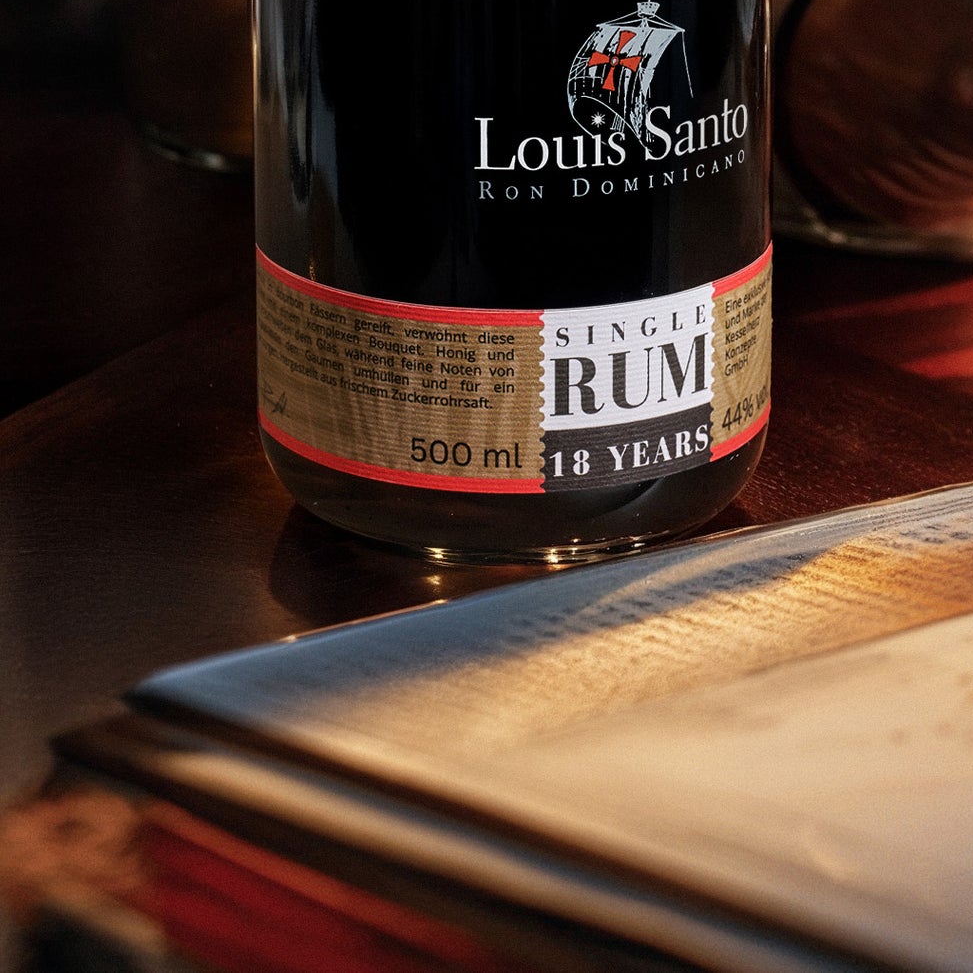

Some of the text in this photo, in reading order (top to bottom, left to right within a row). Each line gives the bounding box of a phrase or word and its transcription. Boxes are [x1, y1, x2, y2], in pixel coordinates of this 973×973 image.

[474, 98, 748, 171] Louis Santo
[724, 296, 743, 314] Eine
[724, 310, 741, 330] und
[306, 318, 360, 345] komplexen
[369, 335, 425, 356] Bouquet.
[436, 346, 476, 363] Honig
[487, 349, 515, 361] und
[404, 328, 468, 344] verwöhnt
[478, 332, 515, 345] diese
[555, 304, 707, 348] SINGLE
[305, 350, 345, 373] Gaumen
[353, 367, 410, 387] umhüllen
[422, 378, 448, 391] und
[460, 379, 481, 393] für
[493, 381, 515, 394] ein
[345, 348, 395, 368] während
[401, 357, 433, 373] feine
[440, 363, 482, 377] Noten
[489, 367, 515, 377] von
[550, 332, 709, 417] RUM
[724, 354, 749, 377] GmbH
[320, 374, 338, 388] aus
[340, 376, 388, 398] frischem
[391, 388, 493, 409] Zuckerrohrsaft.
[721, 393, 754, 431] 44%
[410, 437, 523, 468] 500 ml
[550, 424, 709, 478] 18 YEARS
